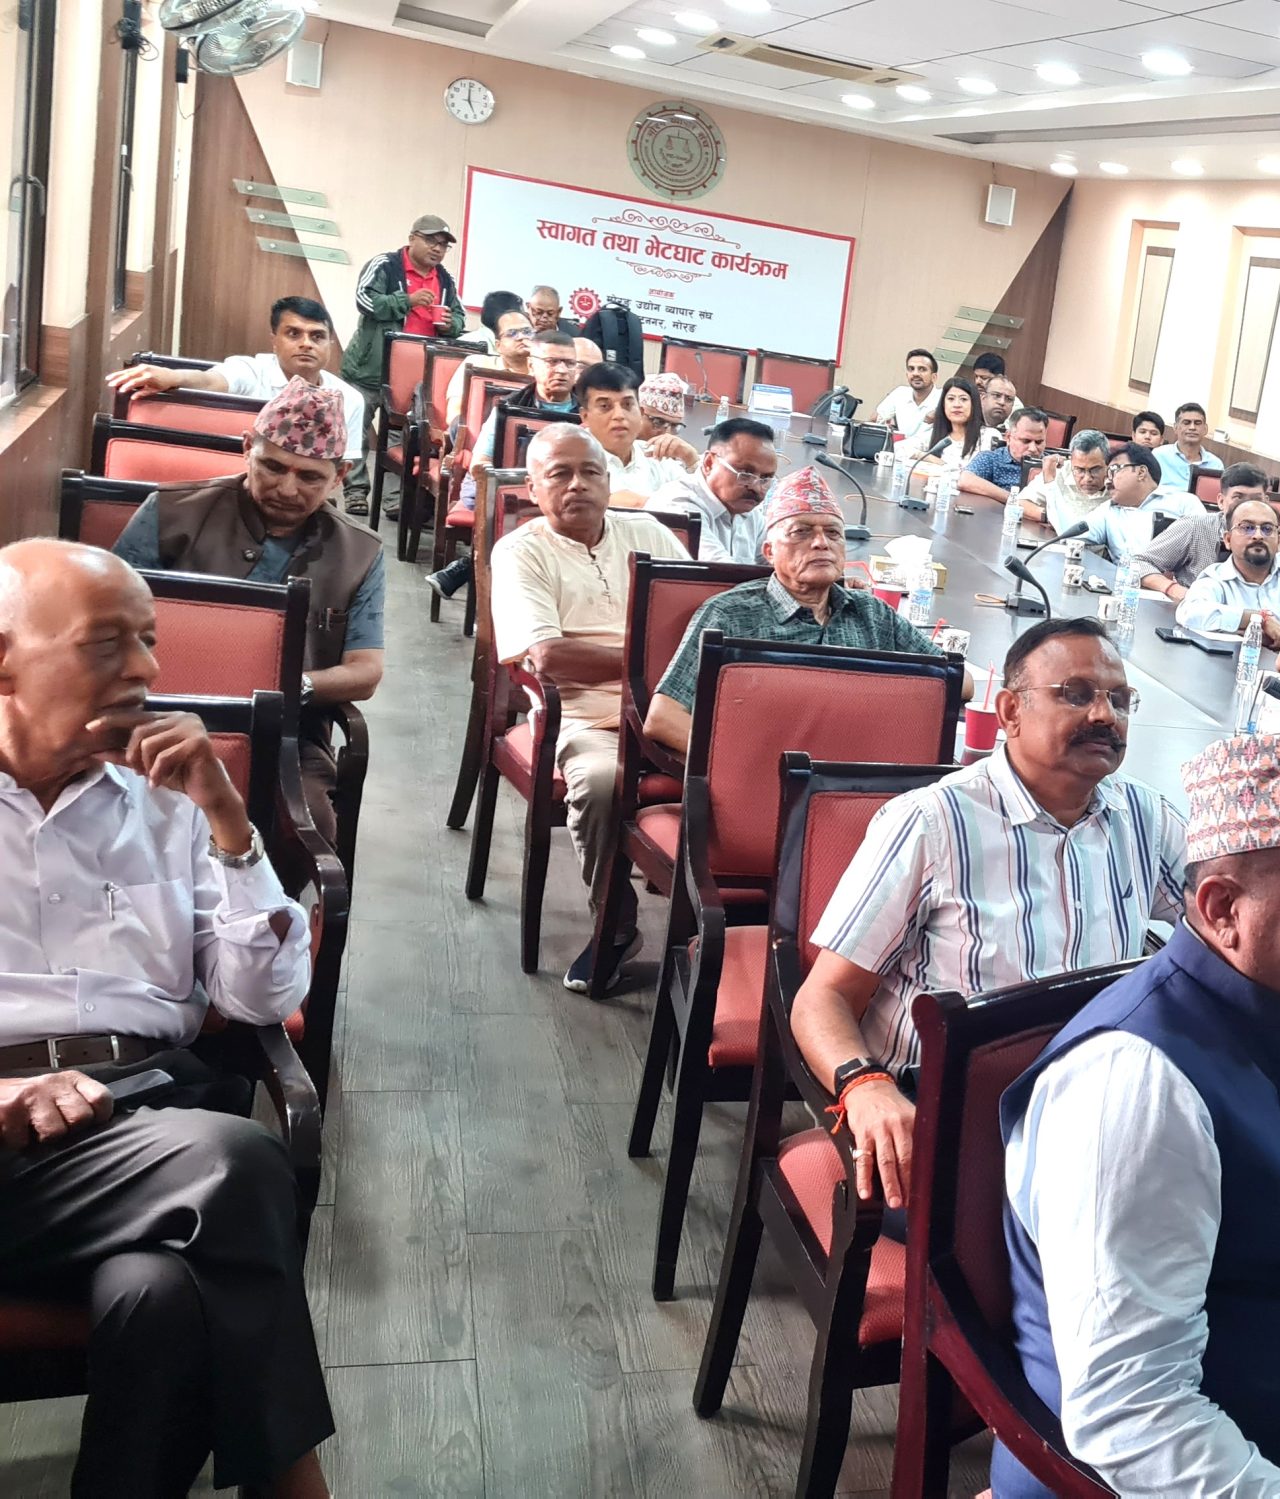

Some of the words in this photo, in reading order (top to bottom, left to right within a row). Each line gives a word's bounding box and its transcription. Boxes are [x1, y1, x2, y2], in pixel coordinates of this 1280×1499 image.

[537, 219, 597, 247] स्वागत
[603, 231, 640, 254] तथा
[645, 235, 707, 266] भेटघाट
[711, 251, 789, 280] कार्यक्रम
